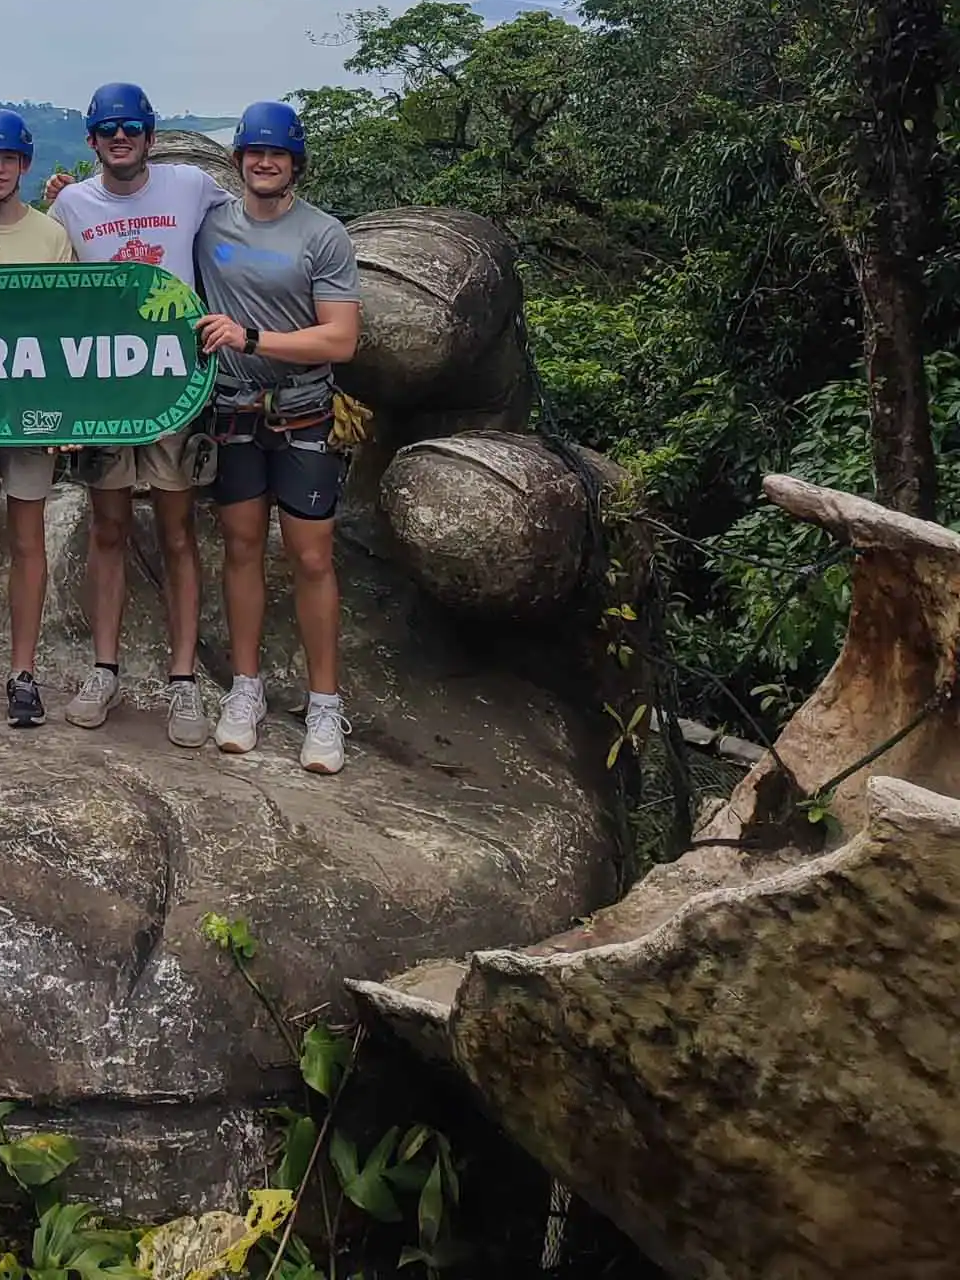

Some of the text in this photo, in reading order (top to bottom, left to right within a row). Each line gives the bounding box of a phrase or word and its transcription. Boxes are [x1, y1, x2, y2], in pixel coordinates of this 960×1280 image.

[81, 216, 176, 240] NC STATE FOOTBALL
[61, 334, 187, 378] VIDA
[22, 410, 62, 431] Sky
